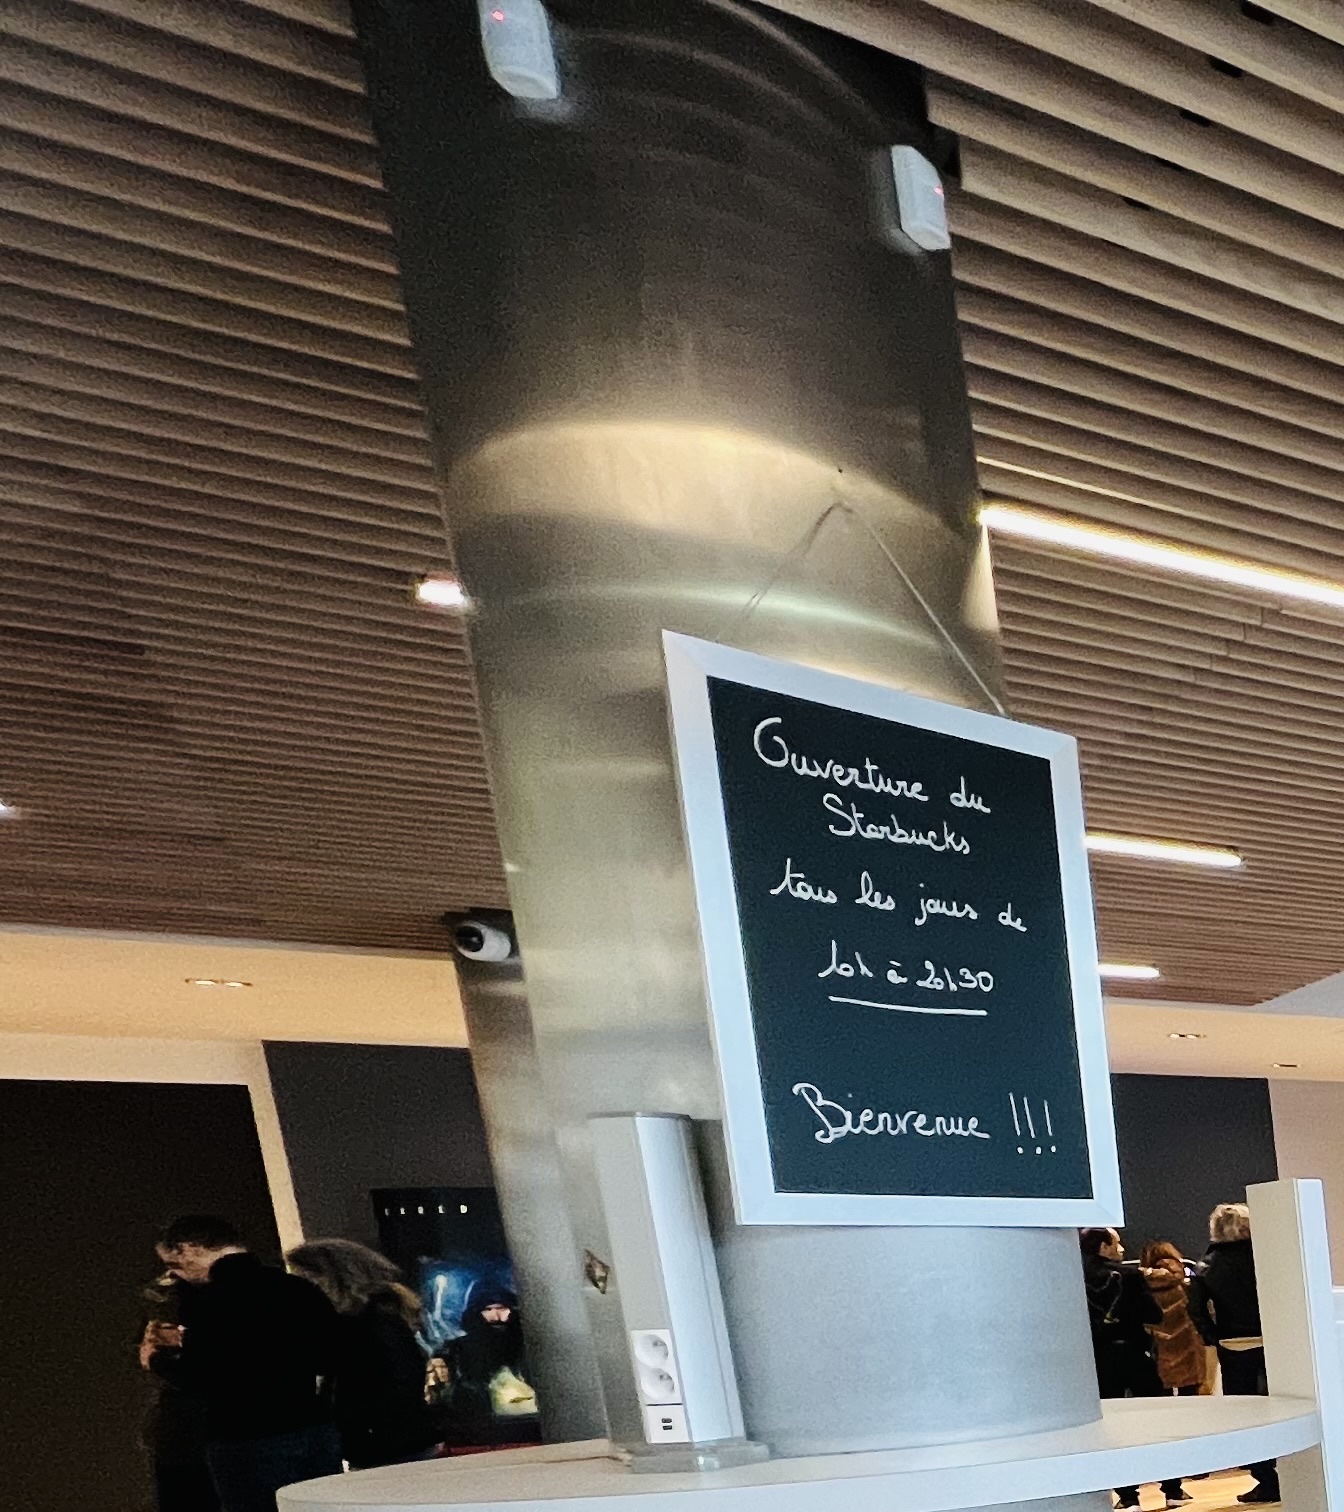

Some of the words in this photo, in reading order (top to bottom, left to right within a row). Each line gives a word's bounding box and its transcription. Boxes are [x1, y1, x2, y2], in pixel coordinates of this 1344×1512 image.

[753, 716, 929, 802] Ouverture
[949, 775, 992, 814] du
[822, 792, 971, 855] Starbucks
[769, 857, 838, 904] tous
[854, 870, 896, 911] les
[914, 882, 979, 927] jours
[997, 902, 1028, 933] de
[791, 1082, 991, 1144] Bienvenue
[1008, 1092, 1057, 1155] !!!
